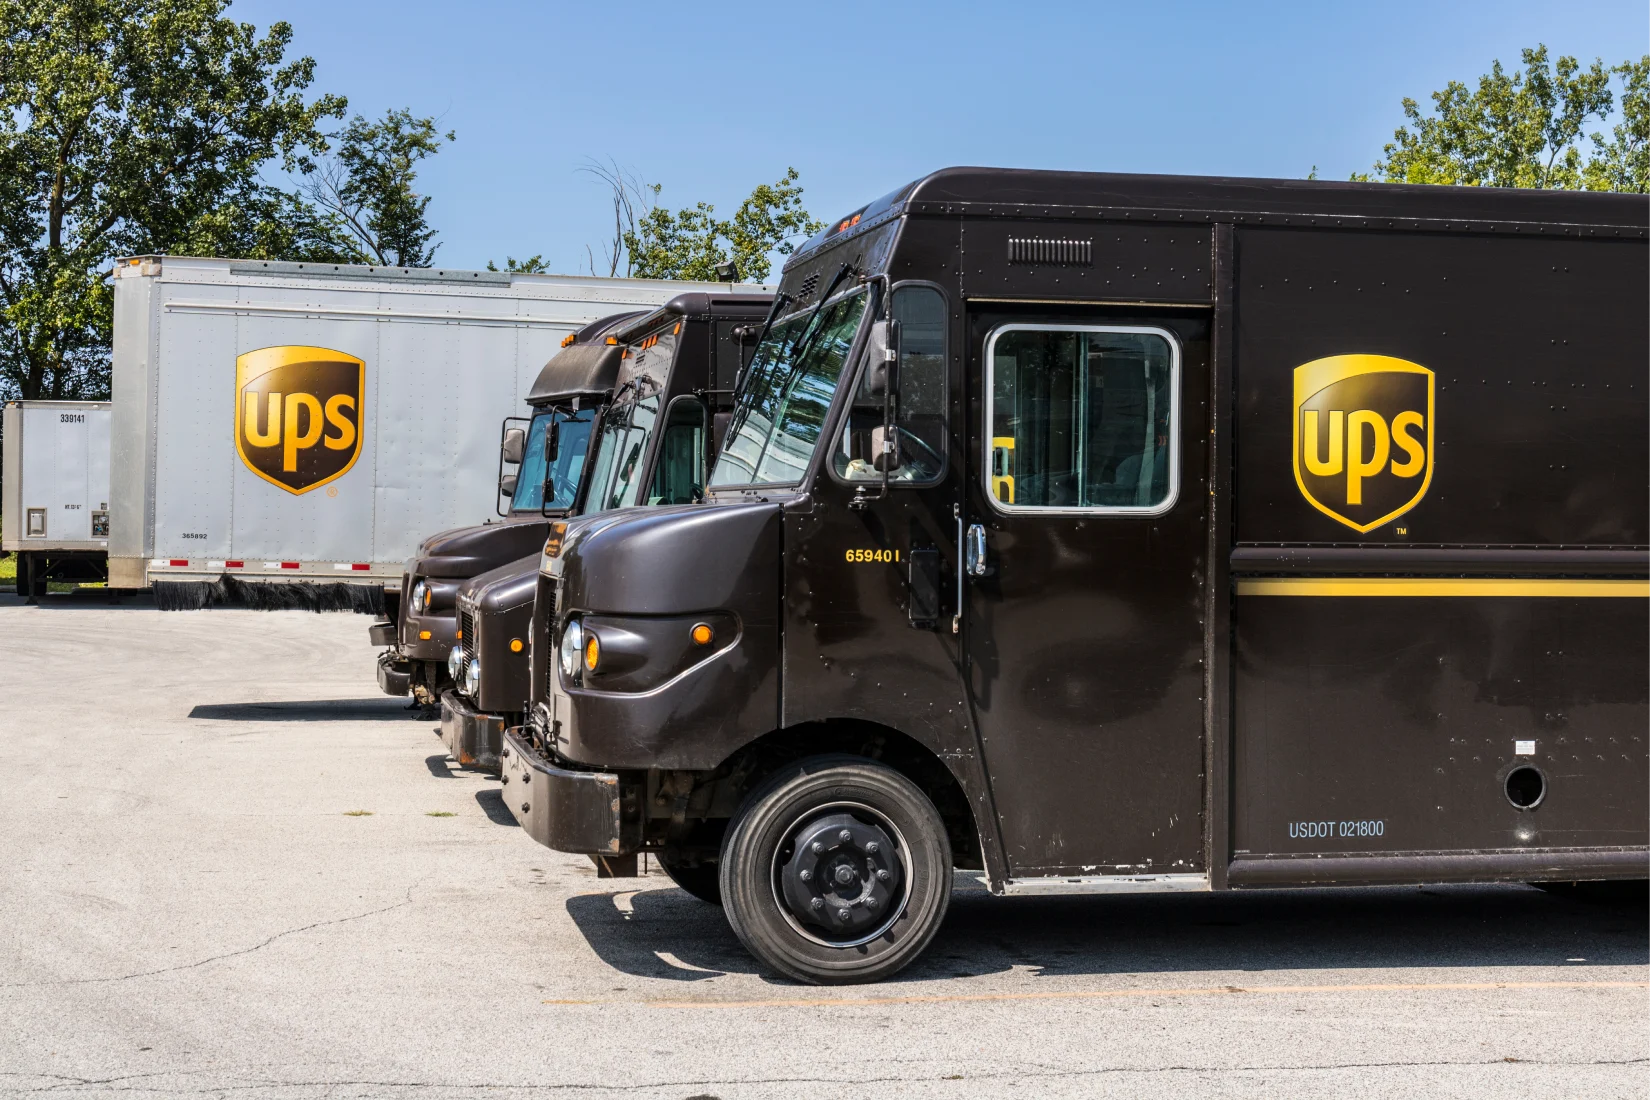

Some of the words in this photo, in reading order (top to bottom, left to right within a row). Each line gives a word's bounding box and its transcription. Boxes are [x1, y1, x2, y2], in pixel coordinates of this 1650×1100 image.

[60, 413, 85, 423] 339141
[245, 391, 355, 472] ups
[1304, 409, 1425, 505] ups
[1396, 527, 1407, 535] TM
[845, 549, 900, 562] 659401
[1289, 821, 1336, 838] USDOT
[1339, 820, 1384, 836] 021800
